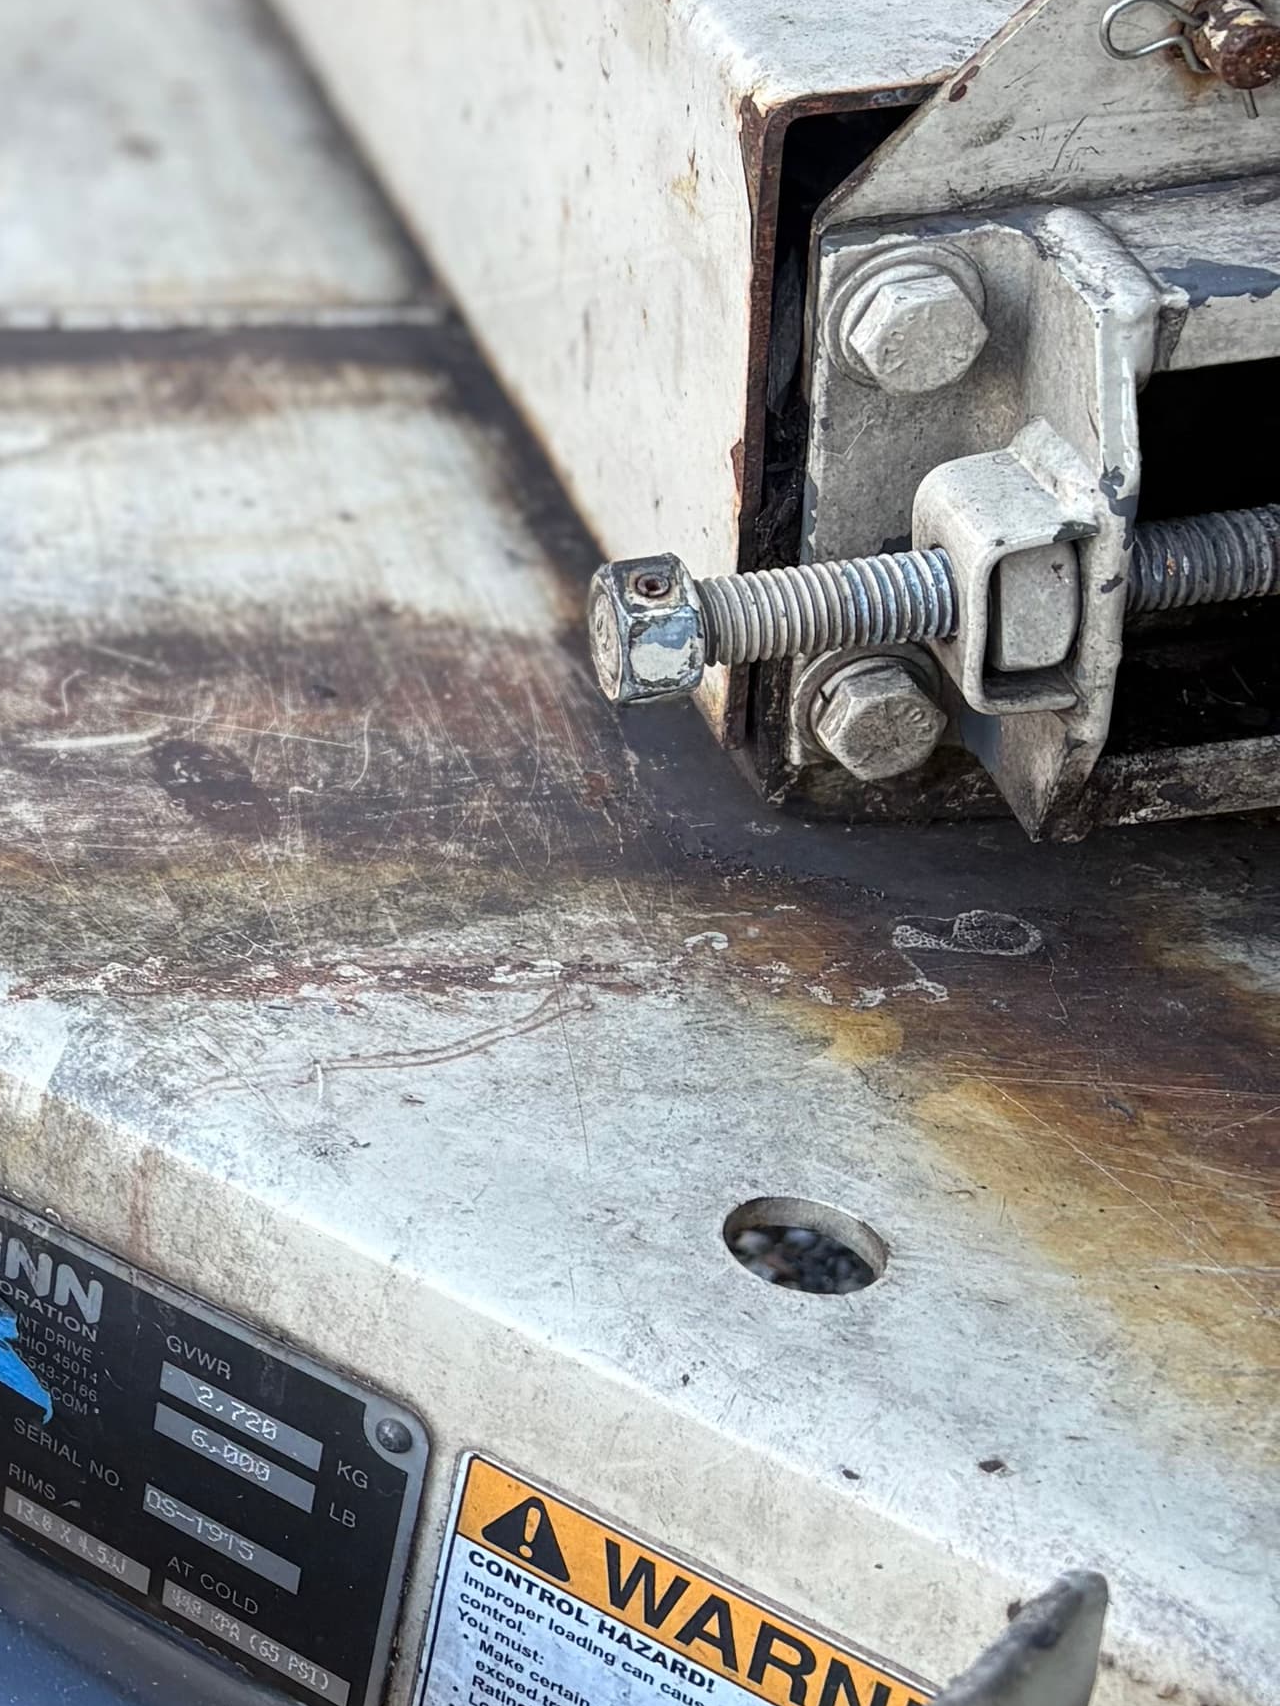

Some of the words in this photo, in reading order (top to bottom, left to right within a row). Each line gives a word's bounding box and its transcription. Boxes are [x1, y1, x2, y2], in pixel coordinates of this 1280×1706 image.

[44, 1327, 93, 1364] DRIVE
[53, 1352, 98, 1384] 45014
[166, 1335, 233, 1381] GVWR
[197, 1385, 278, 1442] 2,720
[13, 1416, 82, 1469] SERIAL
[90, 1459, 125, 1492] NO.
[191, 1428, 271, 1483] 6,000
[336, 1459, 369, 1490] KG
[7, 1462, 57, 1501] RIMS
[328, 1502, 358, 1529] LB
[166, 1555, 195, 1579] AT
[199, 1572, 260, 1616] COLD
[457, 1606, 490, 1636] You
[493, 1629, 545, 1667] must:
[459, 1592, 527, 1637] control.
[464, 1570, 546, 1626] Improper
[548, 1618, 617, 1667] loading
[621, 1659, 656, 1687] can
[468, 1549, 589, 1627] CONTROL
[597, 1619, 716, 1694] HAZARD!
[478, 1638, 525, 1675] Make
[474, 1657, 538, 1702] exceed
